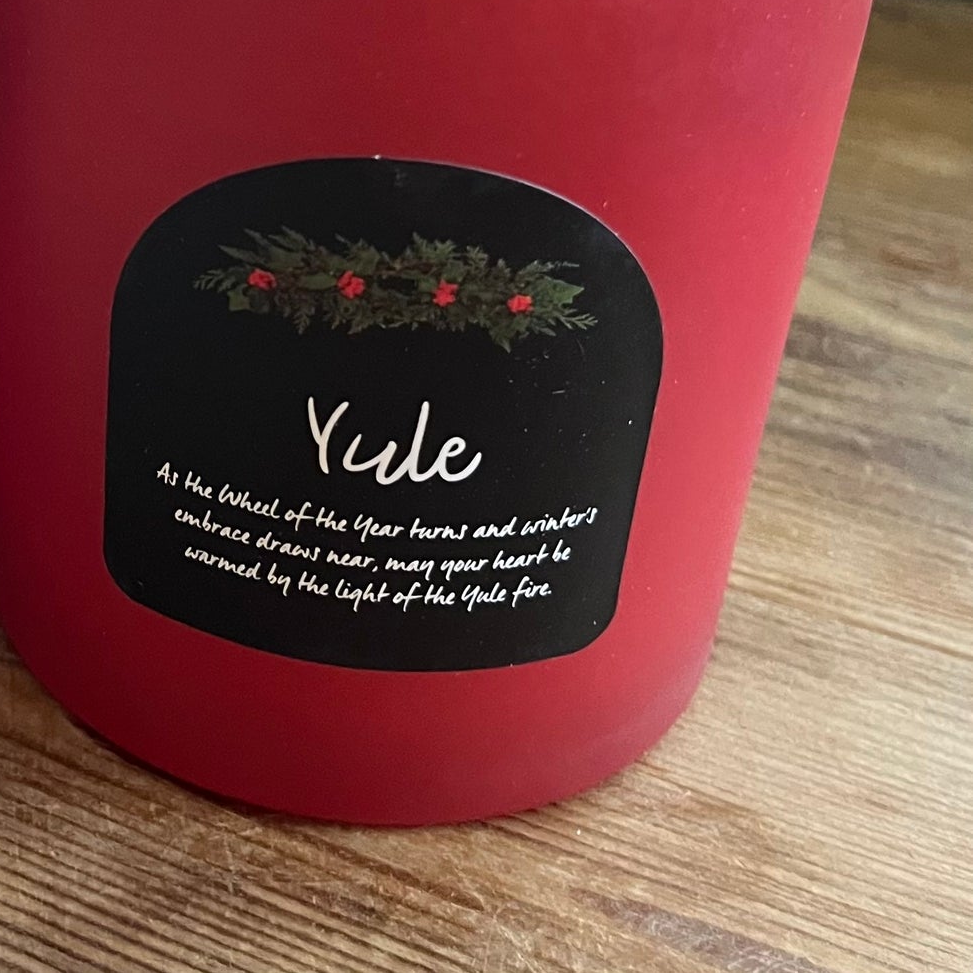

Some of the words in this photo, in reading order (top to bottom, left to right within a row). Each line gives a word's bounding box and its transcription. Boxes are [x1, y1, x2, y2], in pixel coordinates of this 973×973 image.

[307, 396, 483, 486] Yule
[156, 461, 179, 487] As
[184, 470, 213, 499] the
[218, 483, 281, 519] Wheel
[284, 501, 315, 532] of
[315, 506, 348, 532] the
[353, 513, 405, 543] Year
[409, 517, 469, 541] turns
[472, 516, 518, 539] and
[520, 506, 599, 536] winter's
[174, 508, 251, 545] embrace
[255, 531, 321, 562] draws
[326, 550, 379, 573] near,
[384, 557, 435, 582] may
[440, 558, 490, 582] your
[492, 542, 550, 570] heart
[551, 538, 572, 563] be
[184, 546, 261, 580] warmed
[266, 562, 291, 597] by
[298, 570, 329, 596] the
[334, 578, 391, 613] light
[392, 581, 424, 613] of
[423, 583, 456, 606] the
[460, 581, 507, 613] Yule
[511, 575, 552, 608] fire.
